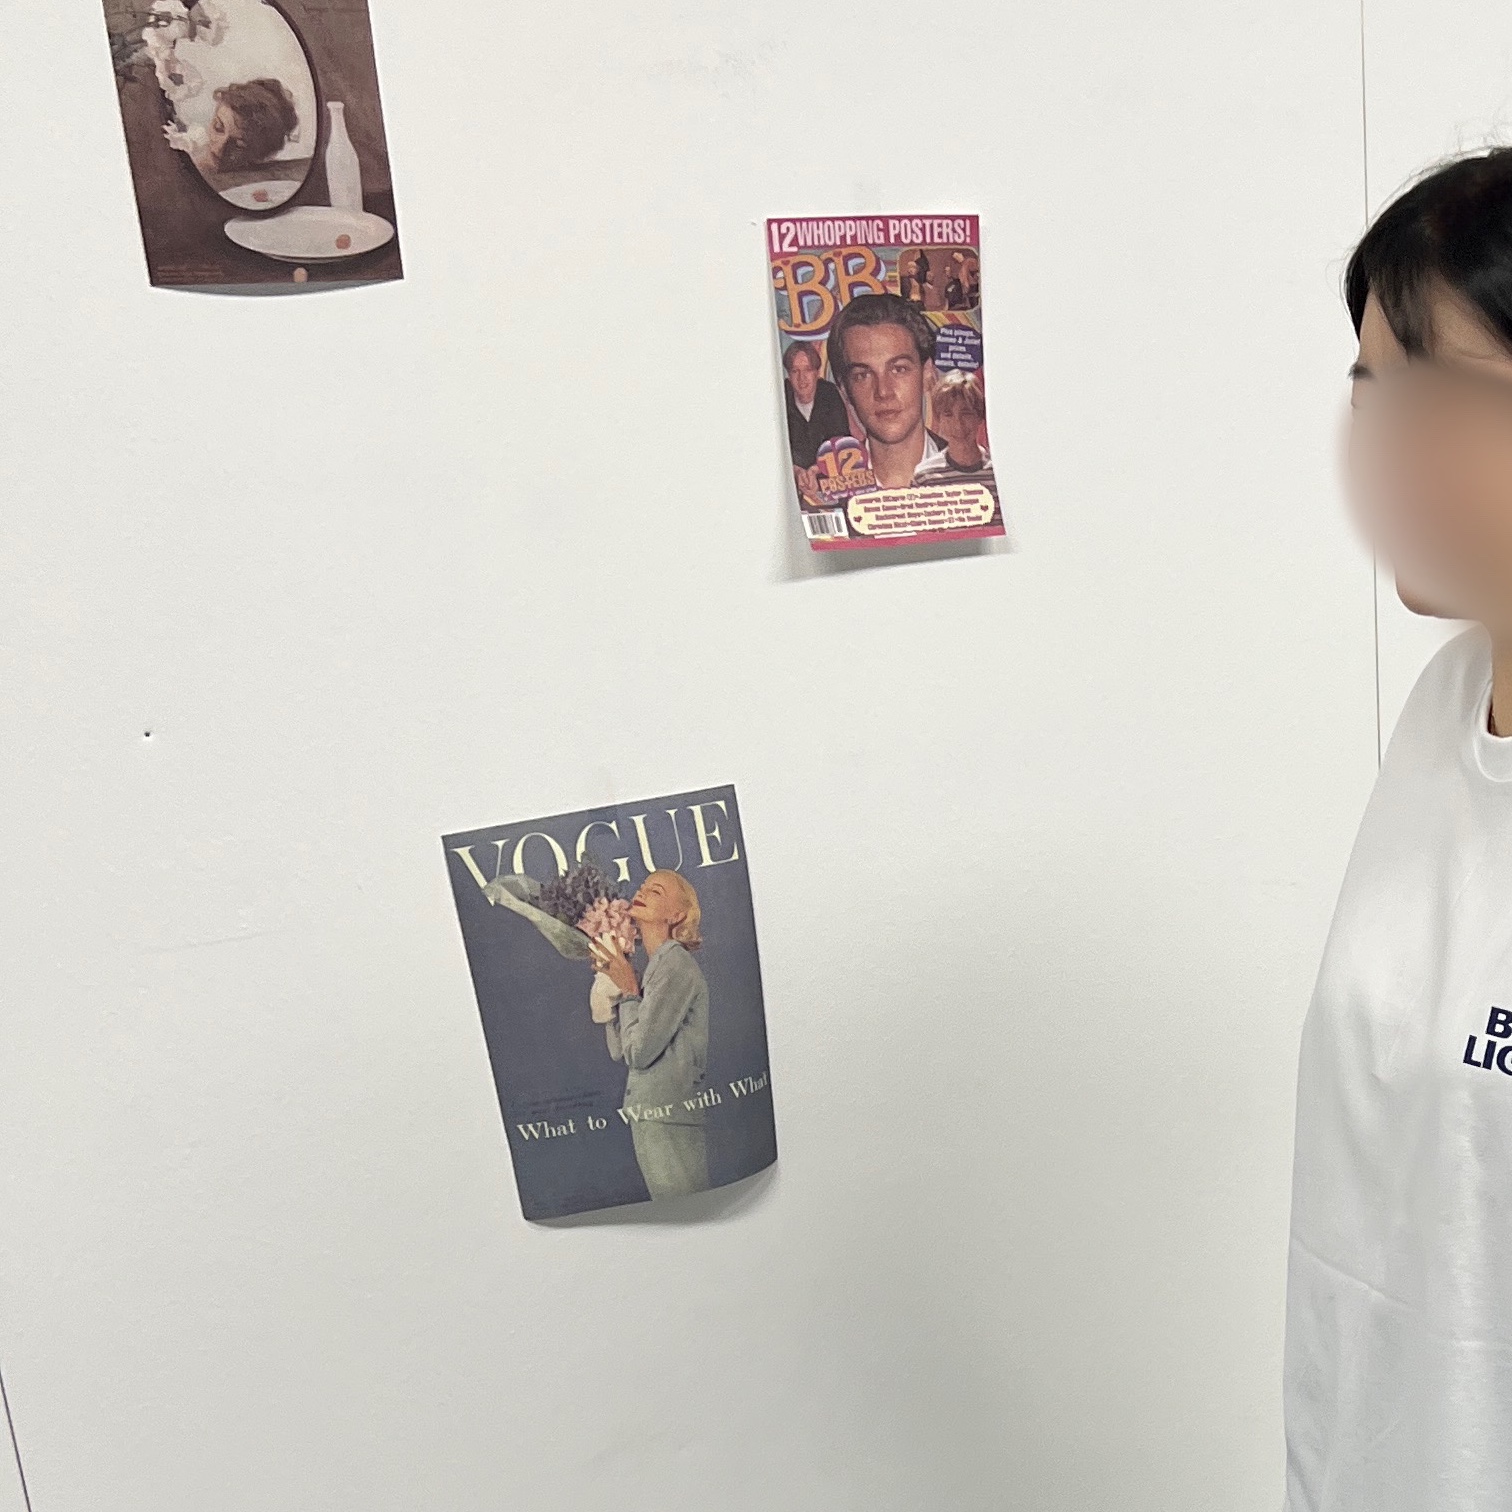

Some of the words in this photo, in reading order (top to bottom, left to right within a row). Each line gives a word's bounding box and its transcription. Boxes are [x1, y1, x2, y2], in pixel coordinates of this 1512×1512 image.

[771, 221, 799, 253] 12
[796, 219, 885, 246] WHOPPING
[889, 218, 971, 244] POSTERS!
[816, 447, 866, 477] 12
[451, 800, 739, 906] VOGUE
[516, 1118, 576, 1141] What
[587, 1115, 607, 1131] to
[616, 1103, 673, 1125] Wear
[683, 1088, 722, 1112] with
[729, 1071, 768, 1098] What
